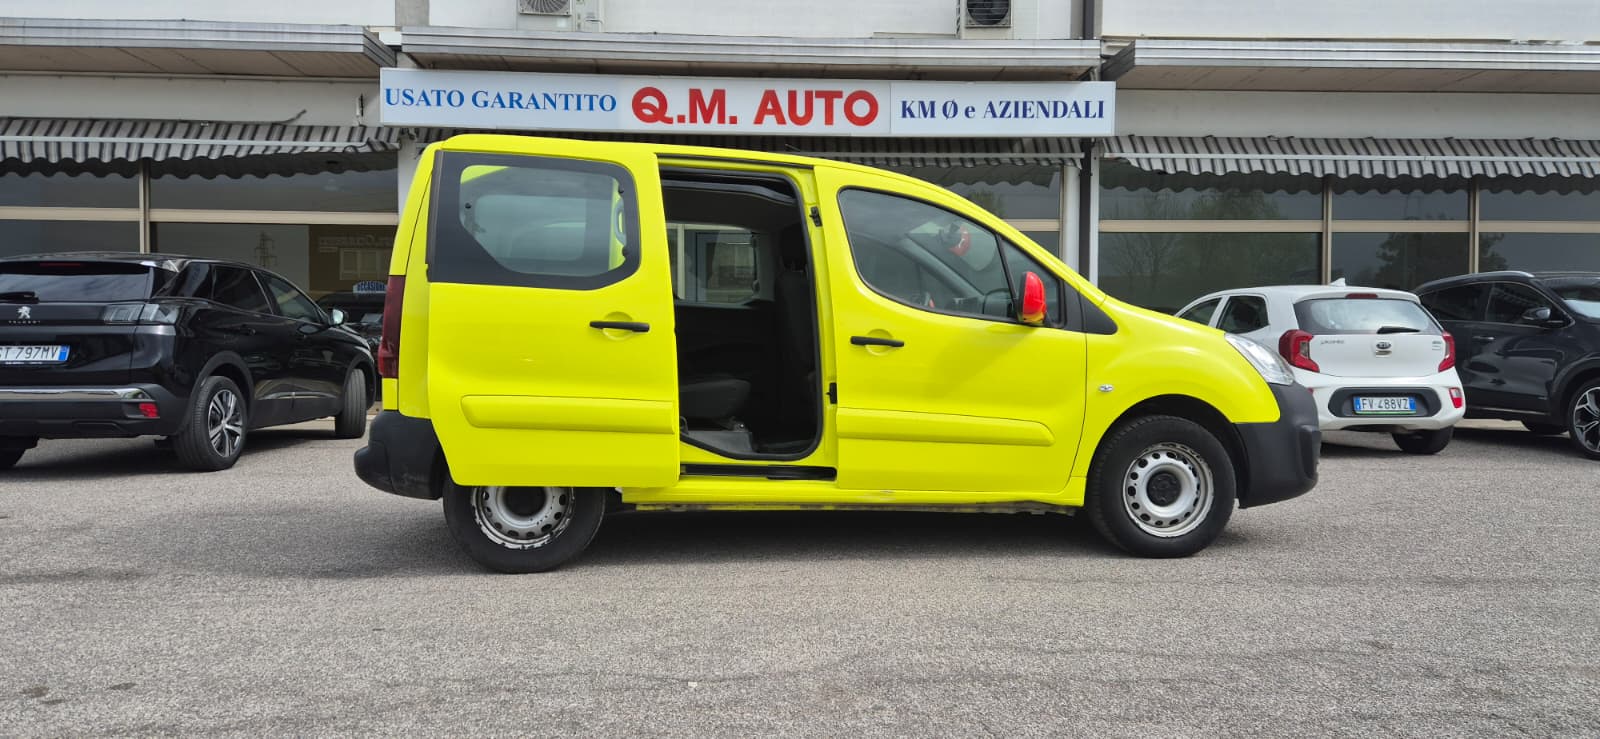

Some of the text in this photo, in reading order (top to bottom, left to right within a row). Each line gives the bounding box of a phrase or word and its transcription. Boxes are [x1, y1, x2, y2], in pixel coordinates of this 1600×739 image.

[384, 88, 617, 112] USATO GARANTITO
[632, 86, 879, 126] Q.M. AUTO
[901, 100, 936, 119] KM
[964, 106, 976, 119] e
[983, 100, 1105, 119] AZIENDALI
[15, 346, 59, 359] 797MV
